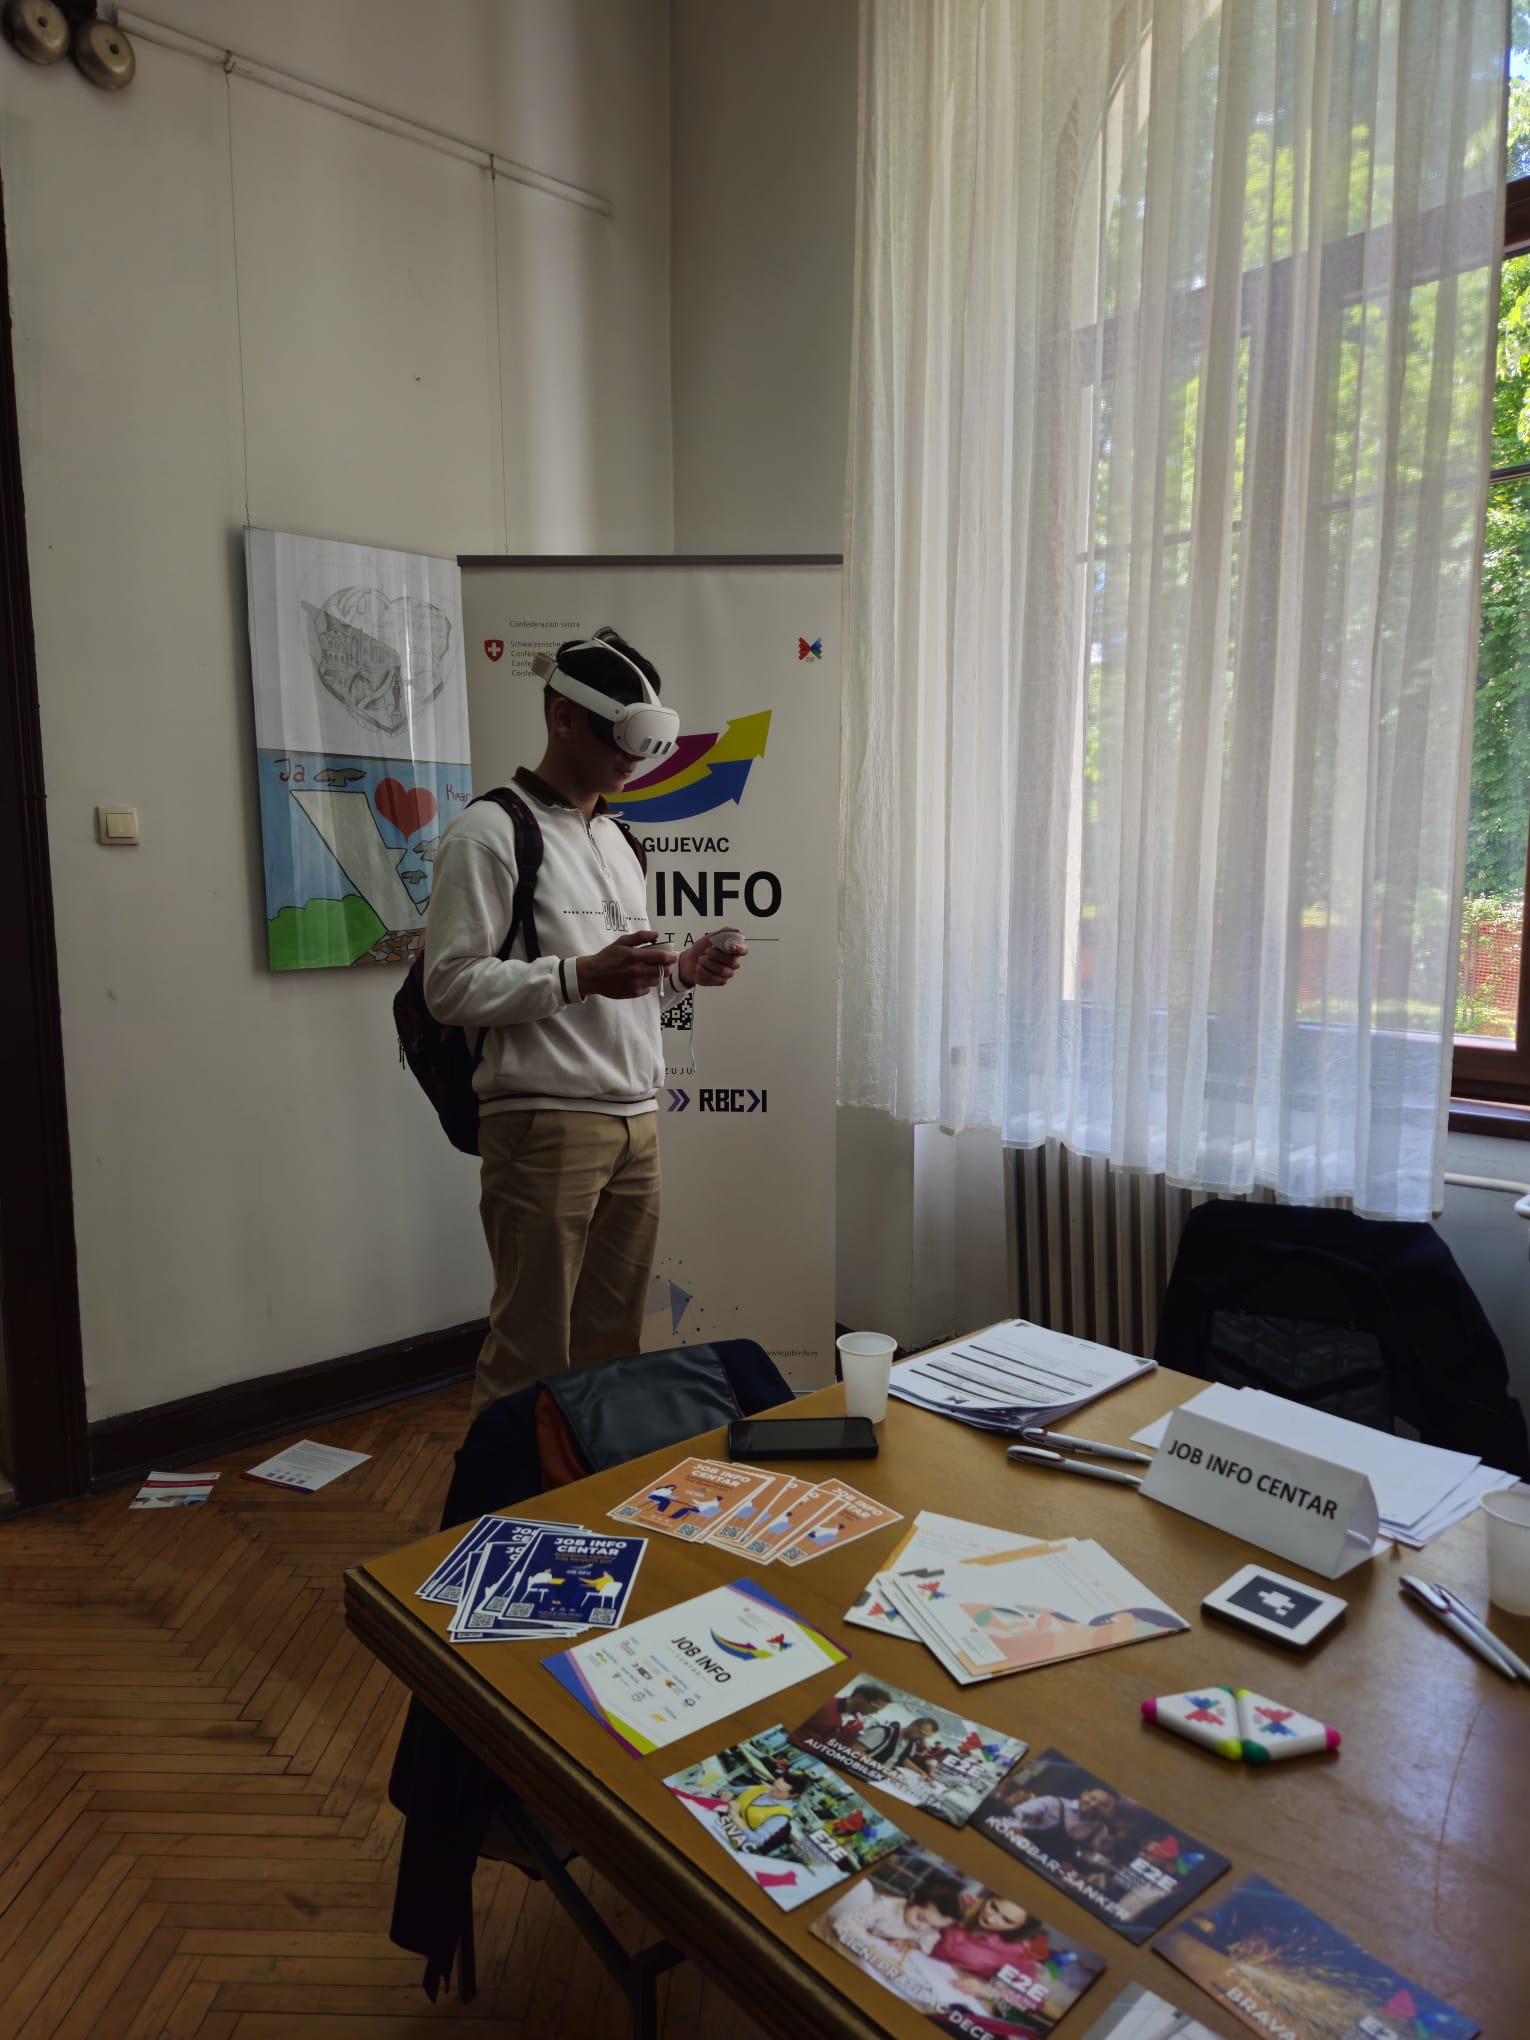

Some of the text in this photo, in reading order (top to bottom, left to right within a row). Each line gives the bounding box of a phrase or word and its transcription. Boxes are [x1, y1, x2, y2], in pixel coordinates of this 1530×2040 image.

[655, 870, 782, 918] INFO
[692, 1463, 721, 1475] JOB
[1167, 1440, 1338, 1520] JOB INFO CENTAR
[553, 1537, 628, 1549] JOB INFO
[556, 1545, 620, 1557] CENTAR
[671, 1636, 701, 1657] JOB
[695, 1655, 732, 1683] INFO
[997, 1963, 1050, 2004] E2E
